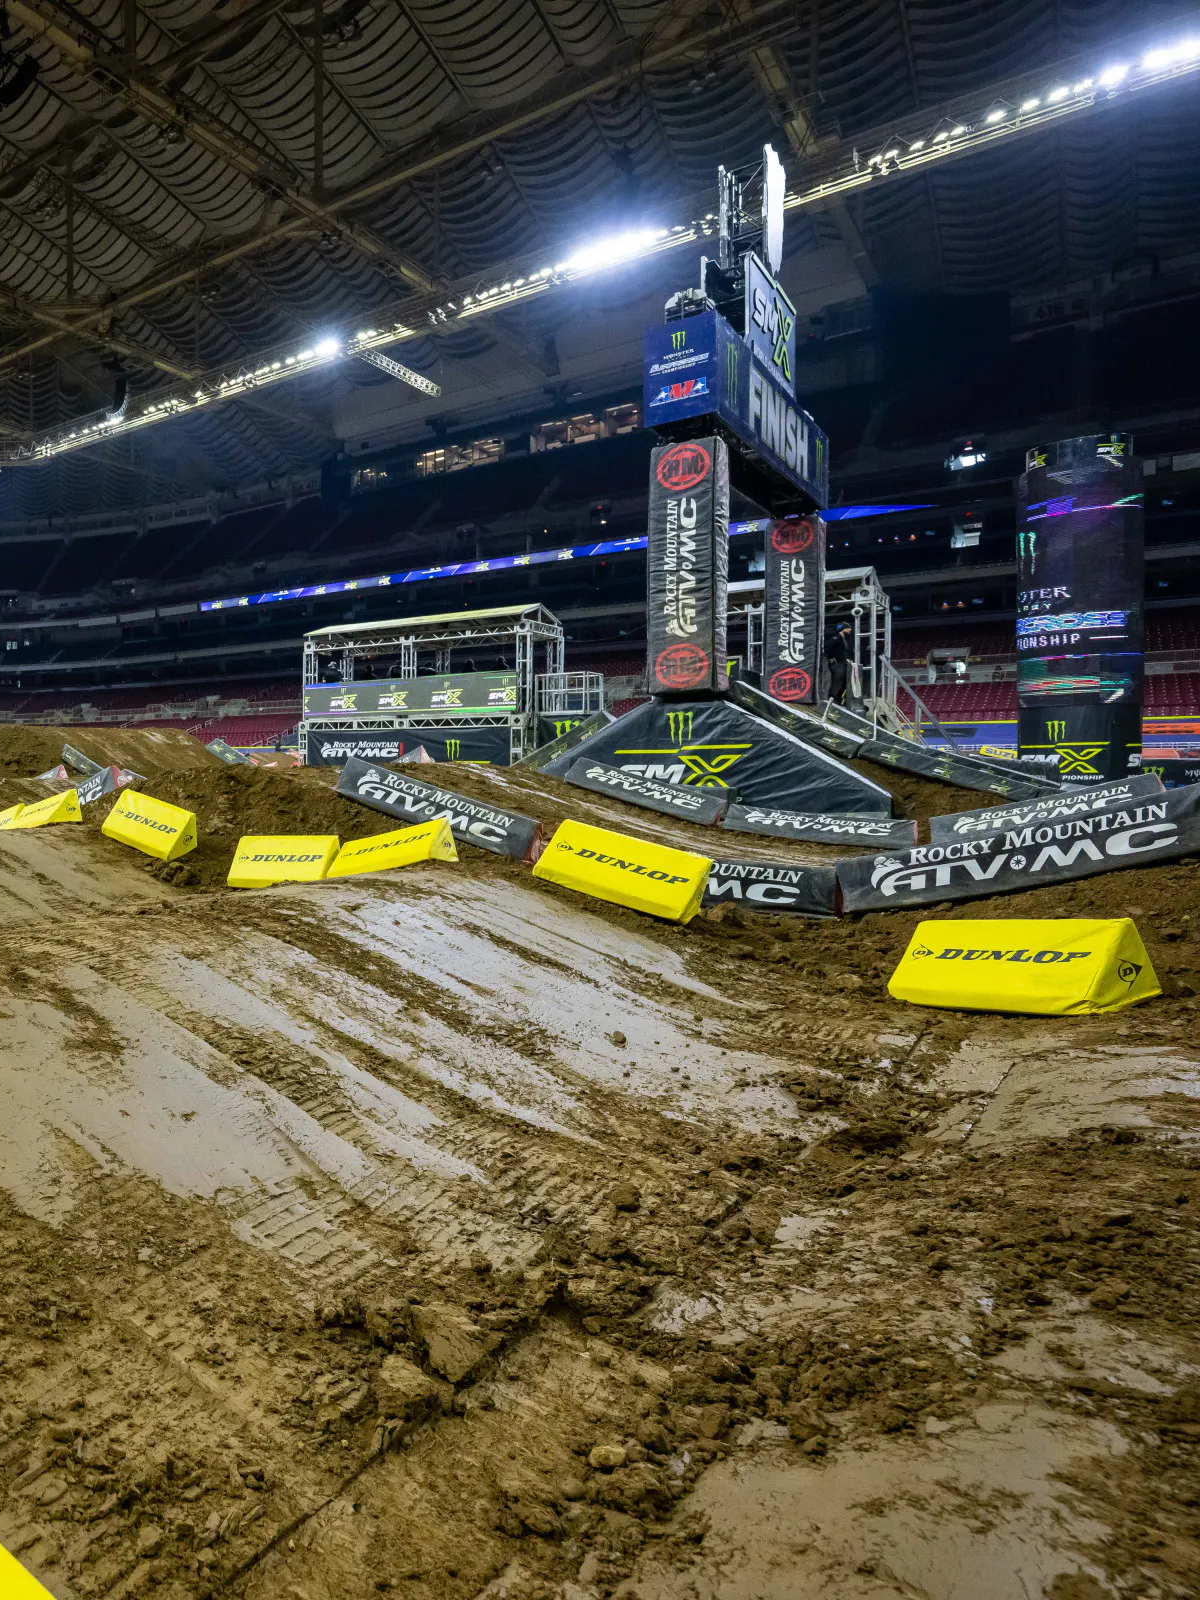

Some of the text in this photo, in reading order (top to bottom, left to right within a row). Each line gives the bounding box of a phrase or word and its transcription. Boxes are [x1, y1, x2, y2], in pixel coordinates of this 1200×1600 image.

[649, 377, 707, 405] AMA
[749, 364, 808, 482] FINISH
[663, 499, 678, 616] ROCKY MOUNTAIN
[778, 559, 790, 648] ROCKY MOUNTAIN
[330, 696, 358, 709] SMX
[378, 694, 408, 707] SMX
[431, 691, 462, 704] SMX
[357, 740, 400, 749] MOUNTAIN
[607, 769, 706, 805] ROCKY MOUNTAIN
[382, 773, 515, 828] ROCKY MOUNTAIN
[980, 784, 1131, 821] ROCKY MOUNTAIN
[124, 811, 178, 834] DUNLOP
[769, 811, 894, 829] ROCKY MOUNTAIN
[355, 832, 432, 856] DUNLOP
[908, 801, 1170, 867] ROCKY MOUNTAIN
[250, 854, 324, 863] DUNLOP
[574, 848, 690, 886] DUNLOP
[935, 948, 1092, 964] DUNLOP
